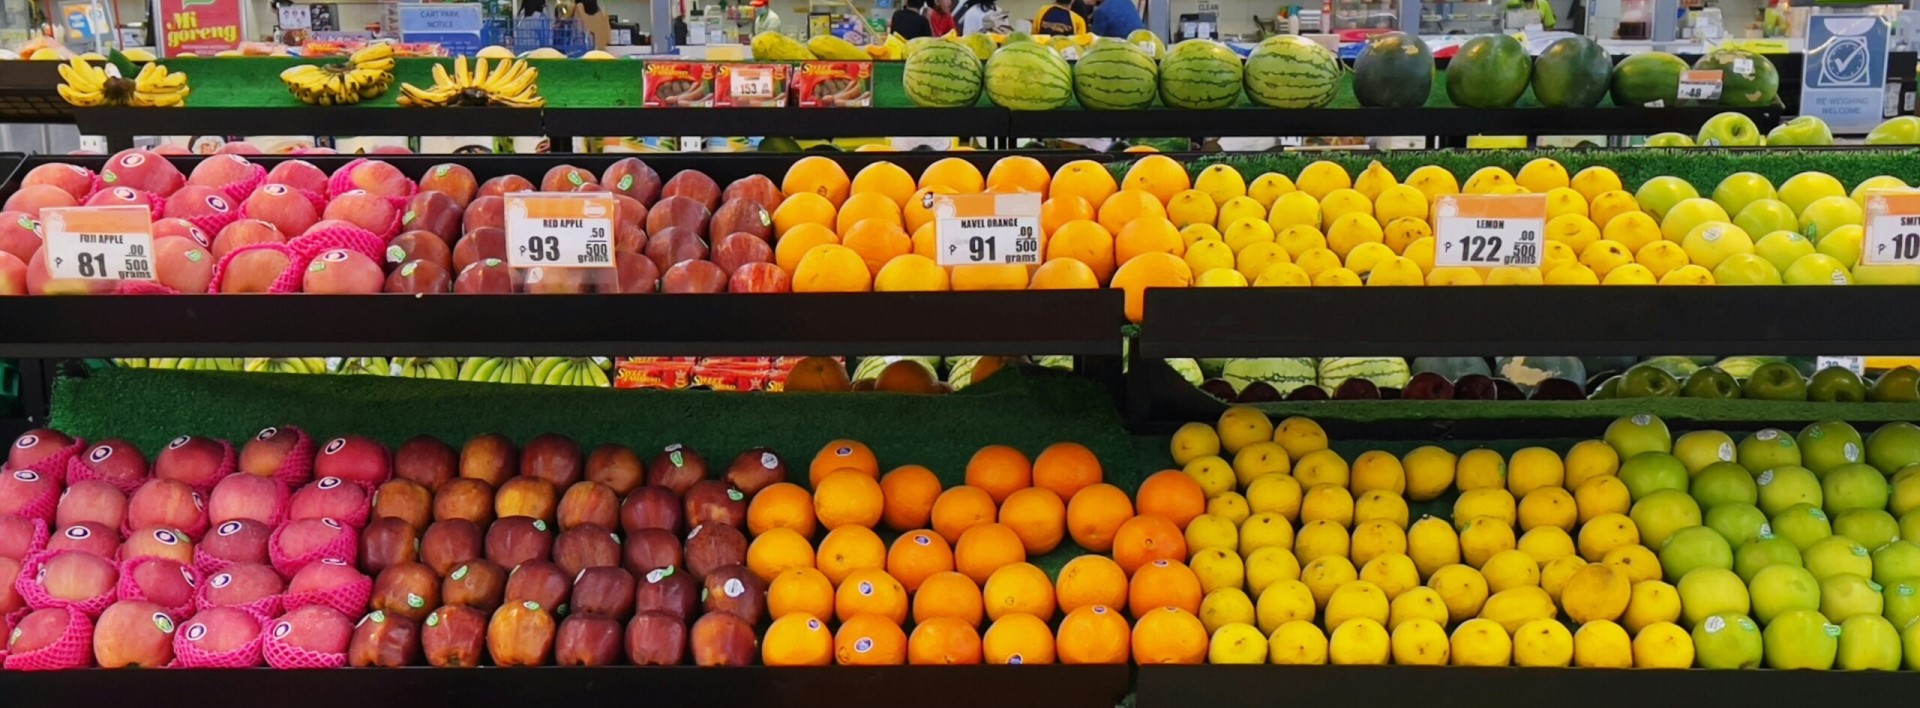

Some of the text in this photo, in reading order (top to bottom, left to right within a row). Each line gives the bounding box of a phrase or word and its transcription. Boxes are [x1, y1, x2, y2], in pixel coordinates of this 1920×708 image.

[421, 10, 460, 18] CART PARK
[166, 11, 198, 30] Mi
[426, 20, 454, 28] NOTICE
[167, 25, 237, 47] goreng
[740, 83, 758, 95] 153
[1815, 97, 1869, 105] RE-WEIGHING
[1822, 106, 1862, 115] WELCOME
[543, 219, 583, 228] RED APPLE
[961, 218, 1018, 229] NAVEL ORANGE
[1476, 220, 1505, 229] LEMON
[80, 234, 124, 244] FUJI APPLE
[528, 235, 560, 262] 93
[586, 243, 608, 256] 500
[969, 235, 996, 262] 91
[1015, 240, 1037, 253] 500
[1459, 235, 1503, 262] 122
[1513, 244, 1536, 257] 500
[577, 254, 609, 264] grams
[1005, 253, 1036, 264] grams
[1503, 254, 1536, 265] grams
[77, 252, 107, 278] 81
[125, 258, 149, 271] 500
[118, 270, 151, 280] grams
